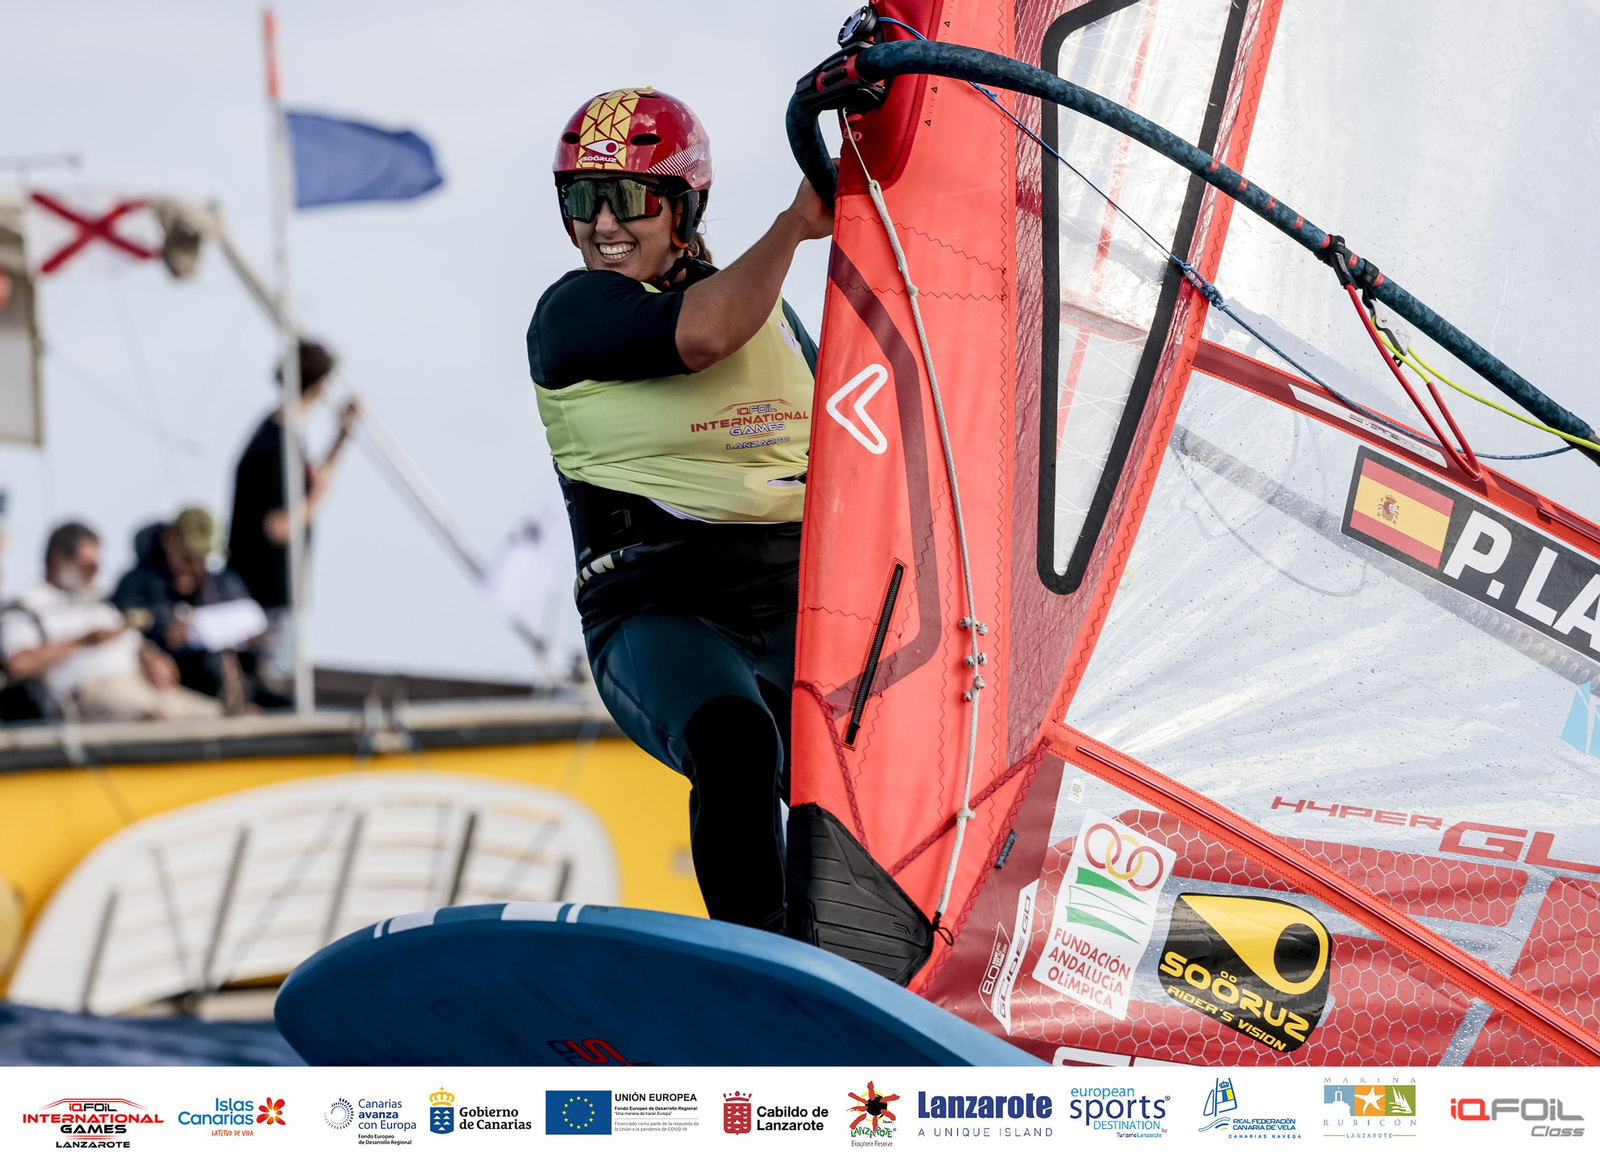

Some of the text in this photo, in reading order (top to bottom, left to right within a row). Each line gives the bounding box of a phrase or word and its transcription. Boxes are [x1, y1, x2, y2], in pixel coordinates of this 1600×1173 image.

[582, 154, 617, 163] SOÖRUZ
[691, 411, 809, 432] INTERNATIONAL
[730, 421, 786, 436] GAMES
[1271, 796, 1443, 831] HYPER
[1054, 927, 1131, 980] FUNDACIÓN
[982, 965, 1000, 995] 8.0
[1166, 985, 1287, 1051] RIDER'S VISION
